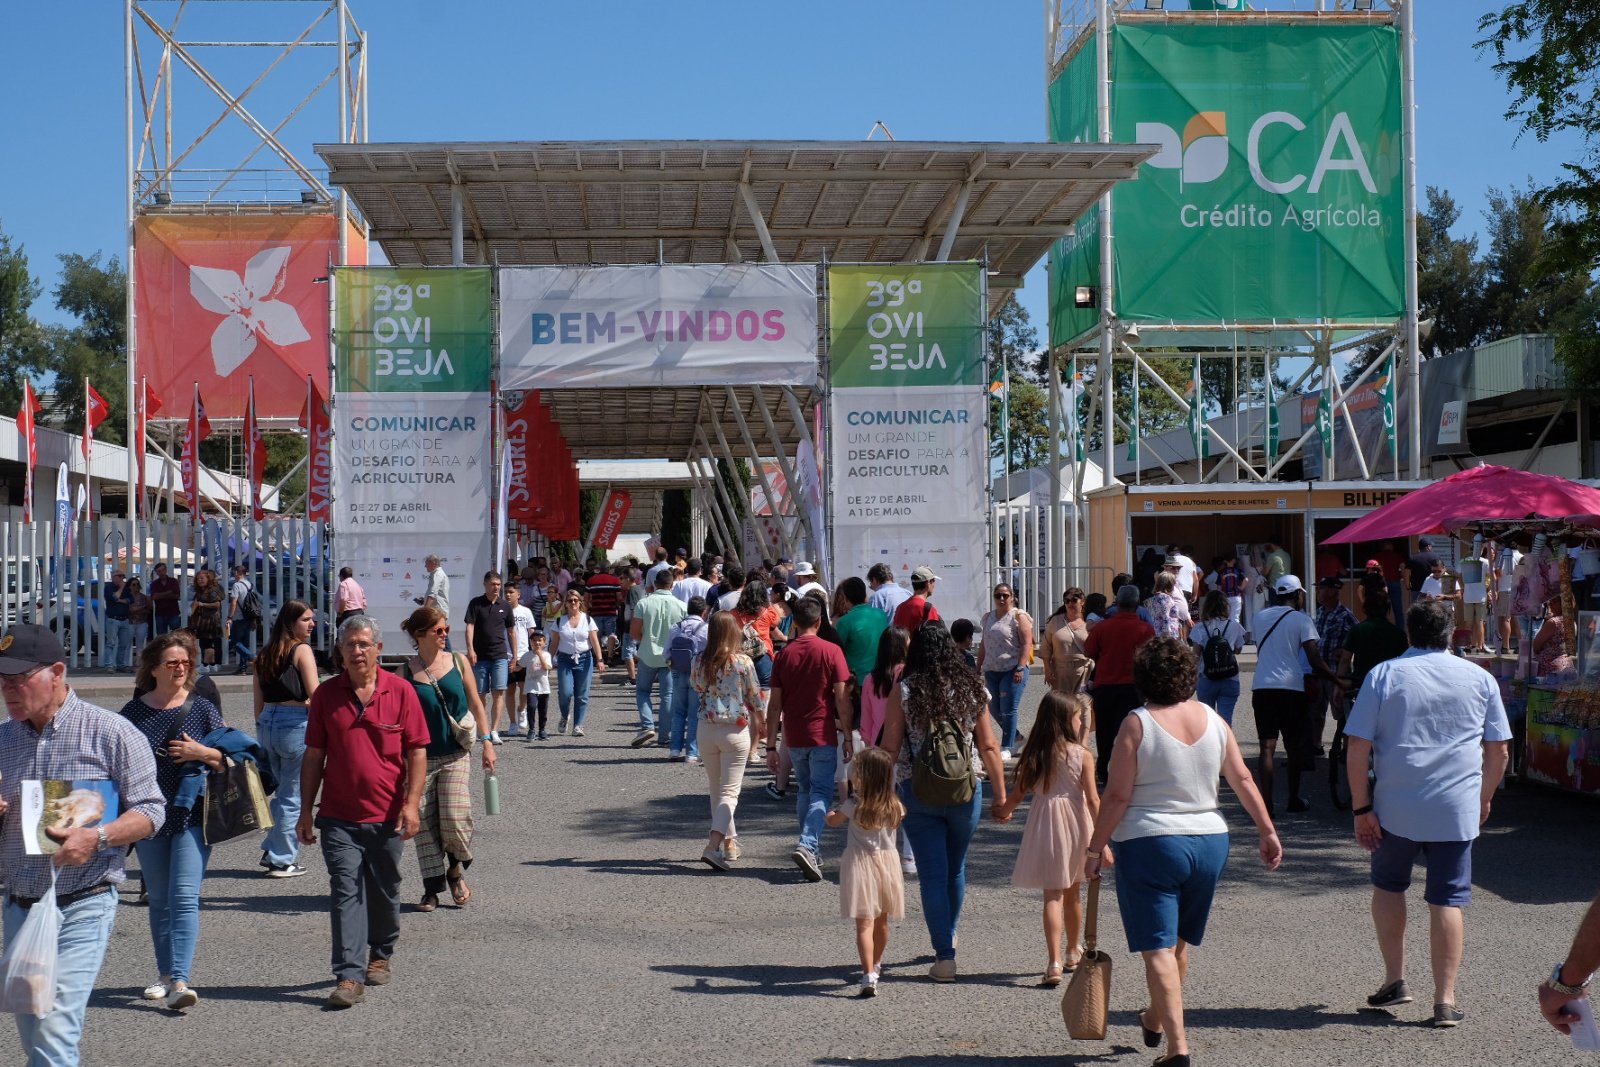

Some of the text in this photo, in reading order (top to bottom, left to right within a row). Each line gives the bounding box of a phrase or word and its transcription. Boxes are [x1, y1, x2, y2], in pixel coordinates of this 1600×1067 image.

[1248, 111, 1378, 194] CA
[1180, 203, 1380, 232] Crédito Agrícola
[373, 317, 431, 343] OVI
[531, 309, 786, 344] BEM-VINDOS
[867, 311, 923, 339] OVI
[375, 349, 455, 376] BEJA
[869, 343, 946, 371] BEJA
[351, 416, 476, 431] COMUNICAR
[847, 410, 969, 425] COMUNICAR
[351, 439, 443, 450] UM GRANDE
[848, 431, 936, 444] UM GRANDE
[352, 456, 476, 466] DESAFIO PARA A
[507, 418, 530, 502] SAGRES
[848, 447, 970, 460] DESAFIO PARA A
[351, 472, 455, 484] AGRICULTURA
[848, 465, 949, 477] AGRICULTURA
[350, 503, 432, 511] DE 27 DE ABRIL
[847, 496, 861, 504] DE
[865, 496, 876, 504] 27
[896, 495, 927, 503] ABRIL
[351, 516, 358, 524] A
[369, 516, 382, 524] DE
[386, 515, 415, 524] MAIO
[848, 509, 856, 517] A
[866, 508, 879, 516] DE
[883, 507, 911, 516] MAIO
[599, 510, 620, 545] SAGRES
